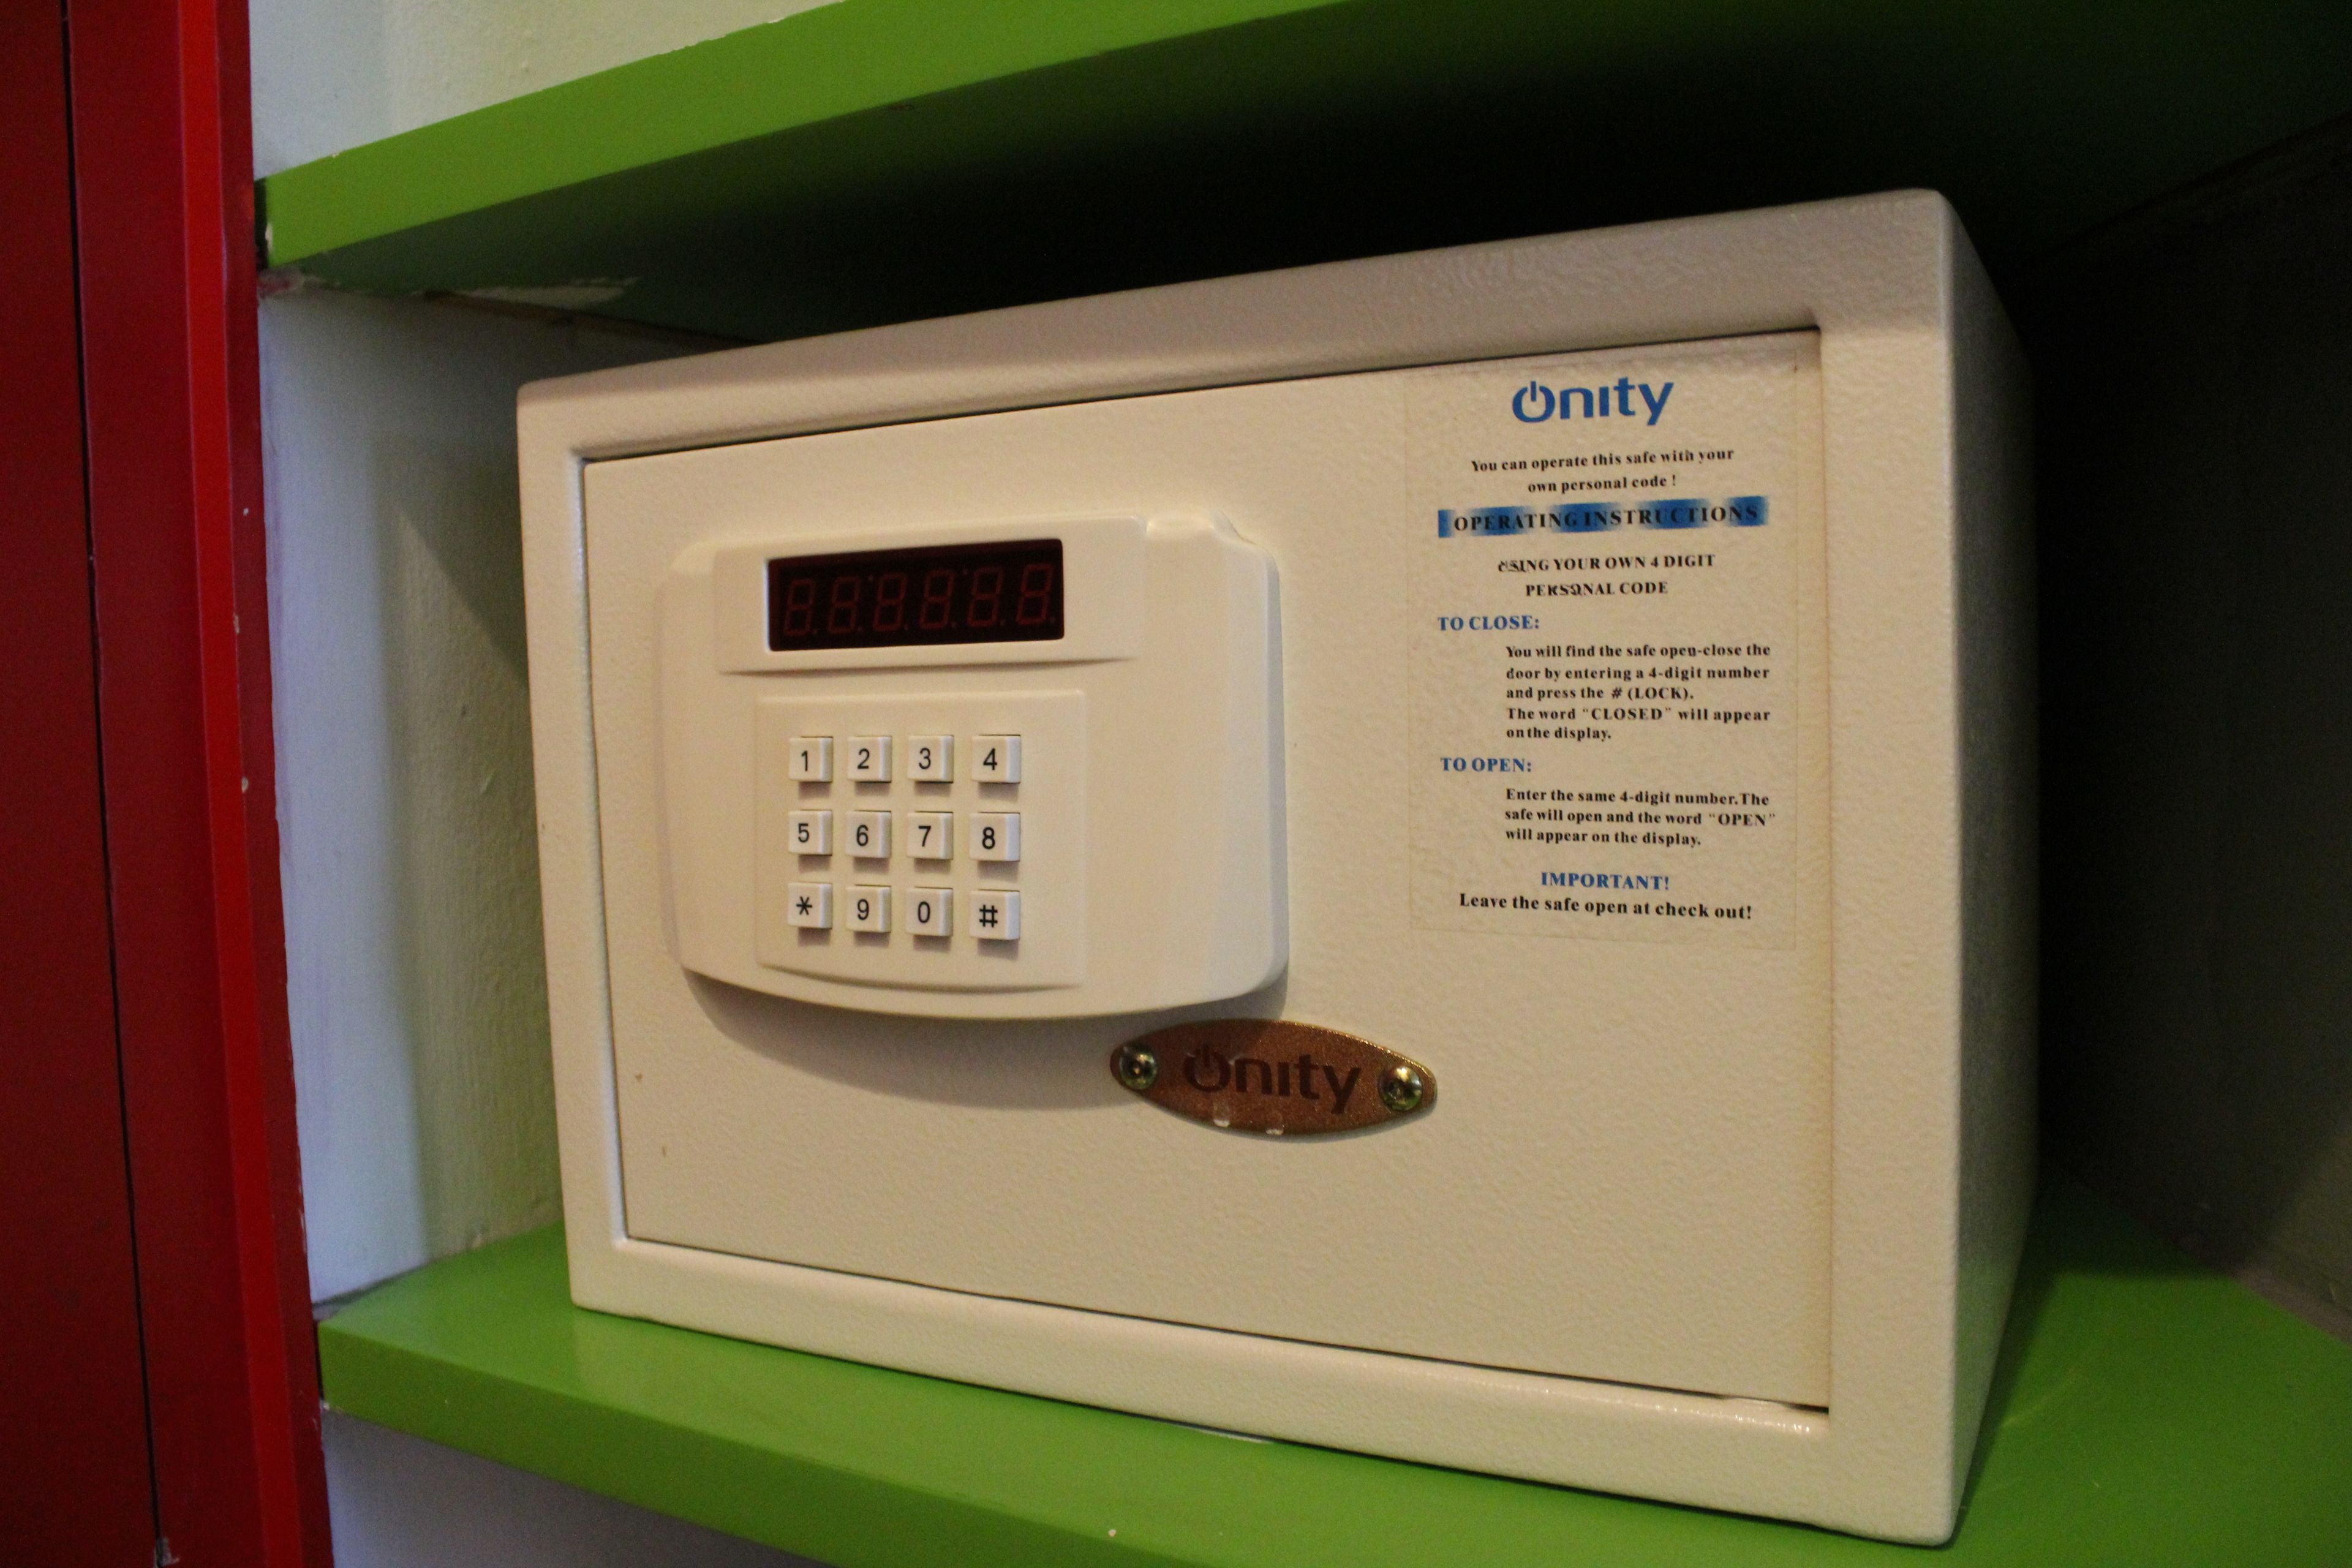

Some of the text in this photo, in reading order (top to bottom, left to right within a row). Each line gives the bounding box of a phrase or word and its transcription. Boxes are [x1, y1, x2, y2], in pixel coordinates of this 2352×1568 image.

[1512, 377, 1674, 425] Onity
[1471, 450, 1735, 472] You can operate this safe with your
[1528, 483, 1557, 492] own
[1561, 477, 1627, 494] personal
[1632, 475, 1667, 488] code
[1455, 505, 1758, 532] OPERATING INSTRUCTIONS
[1553, 557, 1600, 571] YOUR
[1605, 556, 1645, 569] OWN
[1650, 556, 1659, 568] 4
[1664, 554, 1715, 568] DIGIT
[1526, 581, 1668, 597] PERSONAL CODE
[1438, 615, 1539, 631] TO CLOSE:
[1506, 643, 1771, 660] You will find the safe open-close the
[1506, 666, 1770, 682] door by entering a 4-digit number
[1506, 687, 1694, 702] and press the # (LOCK).
[1508, 707, 1534, 720] The
[1539, 708, 1576, 720] word
[1678, 708, 1708, 721] will
[1713, 711, 1771, 725] appear
[1554, 726, 1611, 742] display.
[800, 747, 998, 772] 1 2 3 4
[1440, 757, 1531, 772] TO OPEN:
[1506, 788, 1547, 801] Enter
[1550, 789, 1574, 801] the
[1578, 793, 1616, 802] same
[1619, 790, 1670, 806] 4-digit
[1505, 808, 1533, 821] safe
[1536, 809, 1563, 821] will
[1567, 812, 1602, 824] open
[1607, 811, 1634, 823] and
[1638, 812, 1661, 824] the
[1665, 813, 1702, 825] word
[797, 823, 996, 850] 5 6 7 8
[1506, 827, 1701, 848] will appear on the display.
[1541, 872, 1669, 891] IMPORTANT!
[856, 899, 870, 921] 9
[918, 901, 931, 924] 0
[1460, 892, 1752, 920] Leave the safe open at check out!
[1185, 1045, 1361, 1115] Onity
